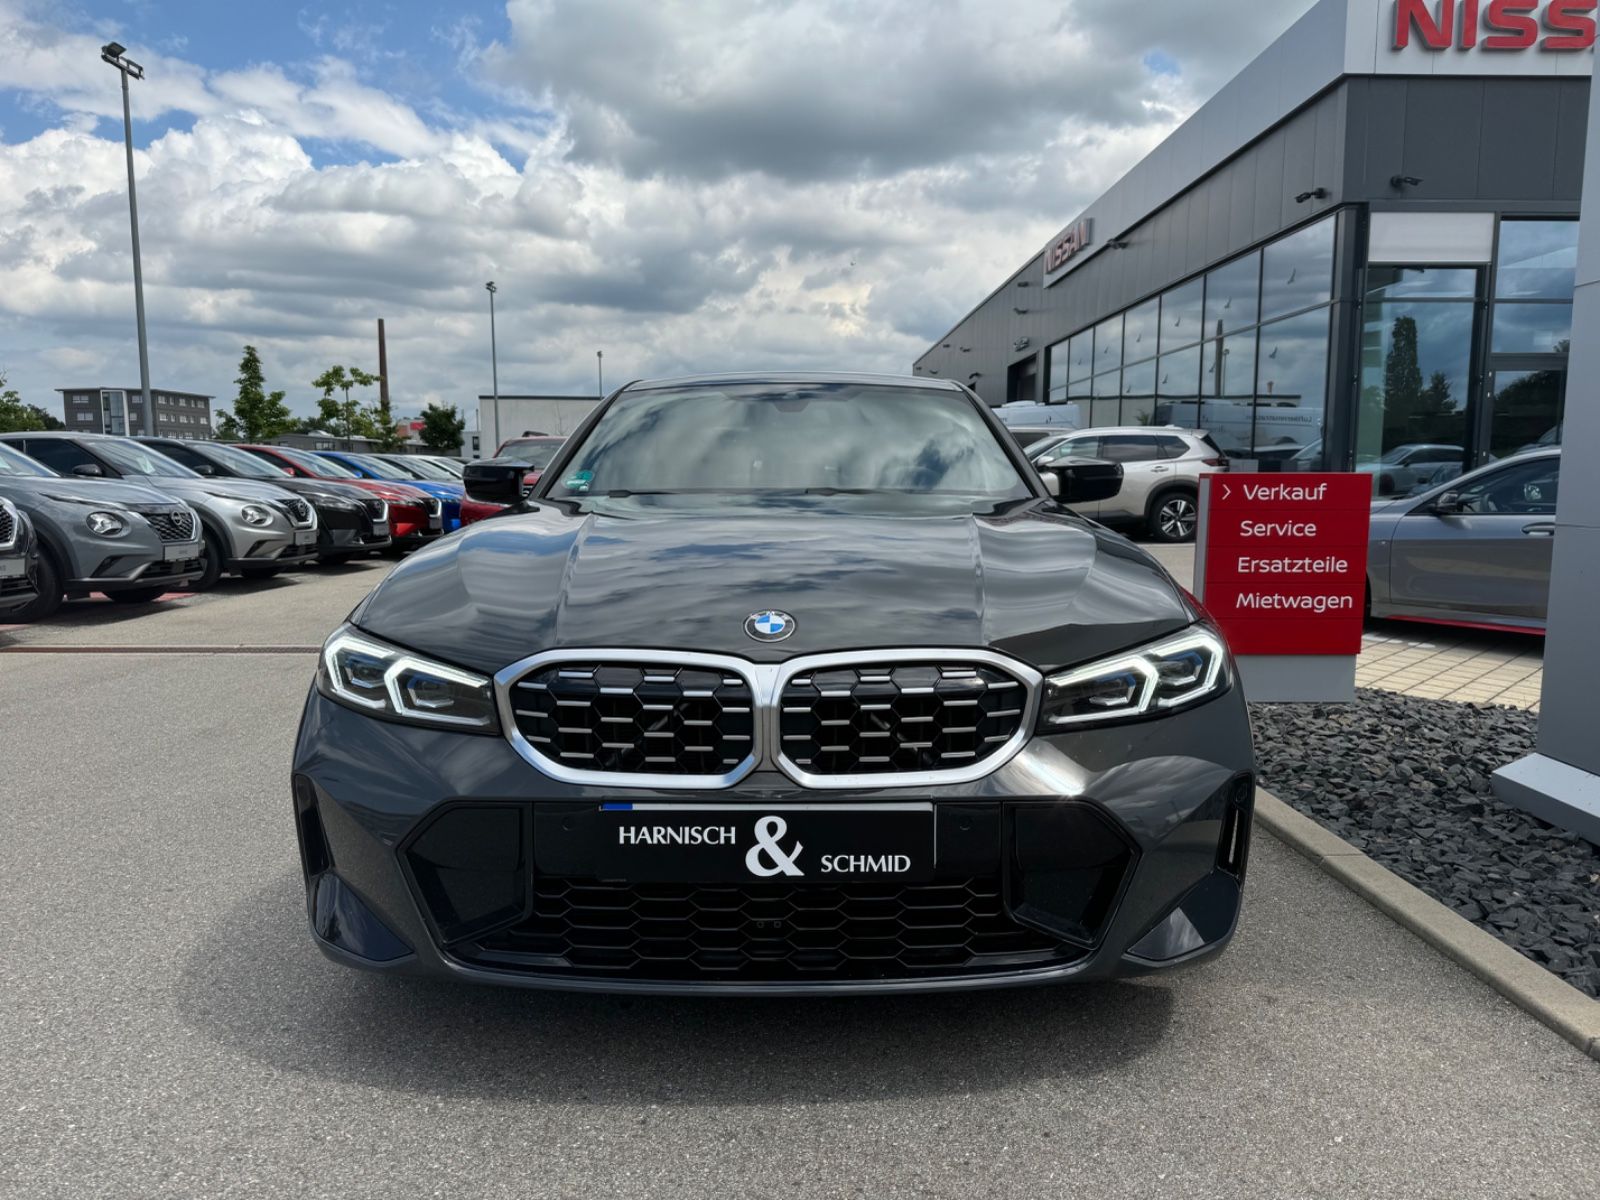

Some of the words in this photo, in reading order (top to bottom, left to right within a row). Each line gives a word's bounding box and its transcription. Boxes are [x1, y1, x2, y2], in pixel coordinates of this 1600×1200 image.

[1243, 483, 1328, 500] Verkauf
[1239, 520, 1317, 537] Service
[1237, 556, 1348, 573] Ersatzteile
[1236, 592, 1353, 613] Mietwagen
[618, 826, 736, 845] HARNISCH
[745, 815, 805, 877] &
[820, 855, 911, 873] SCHMID
